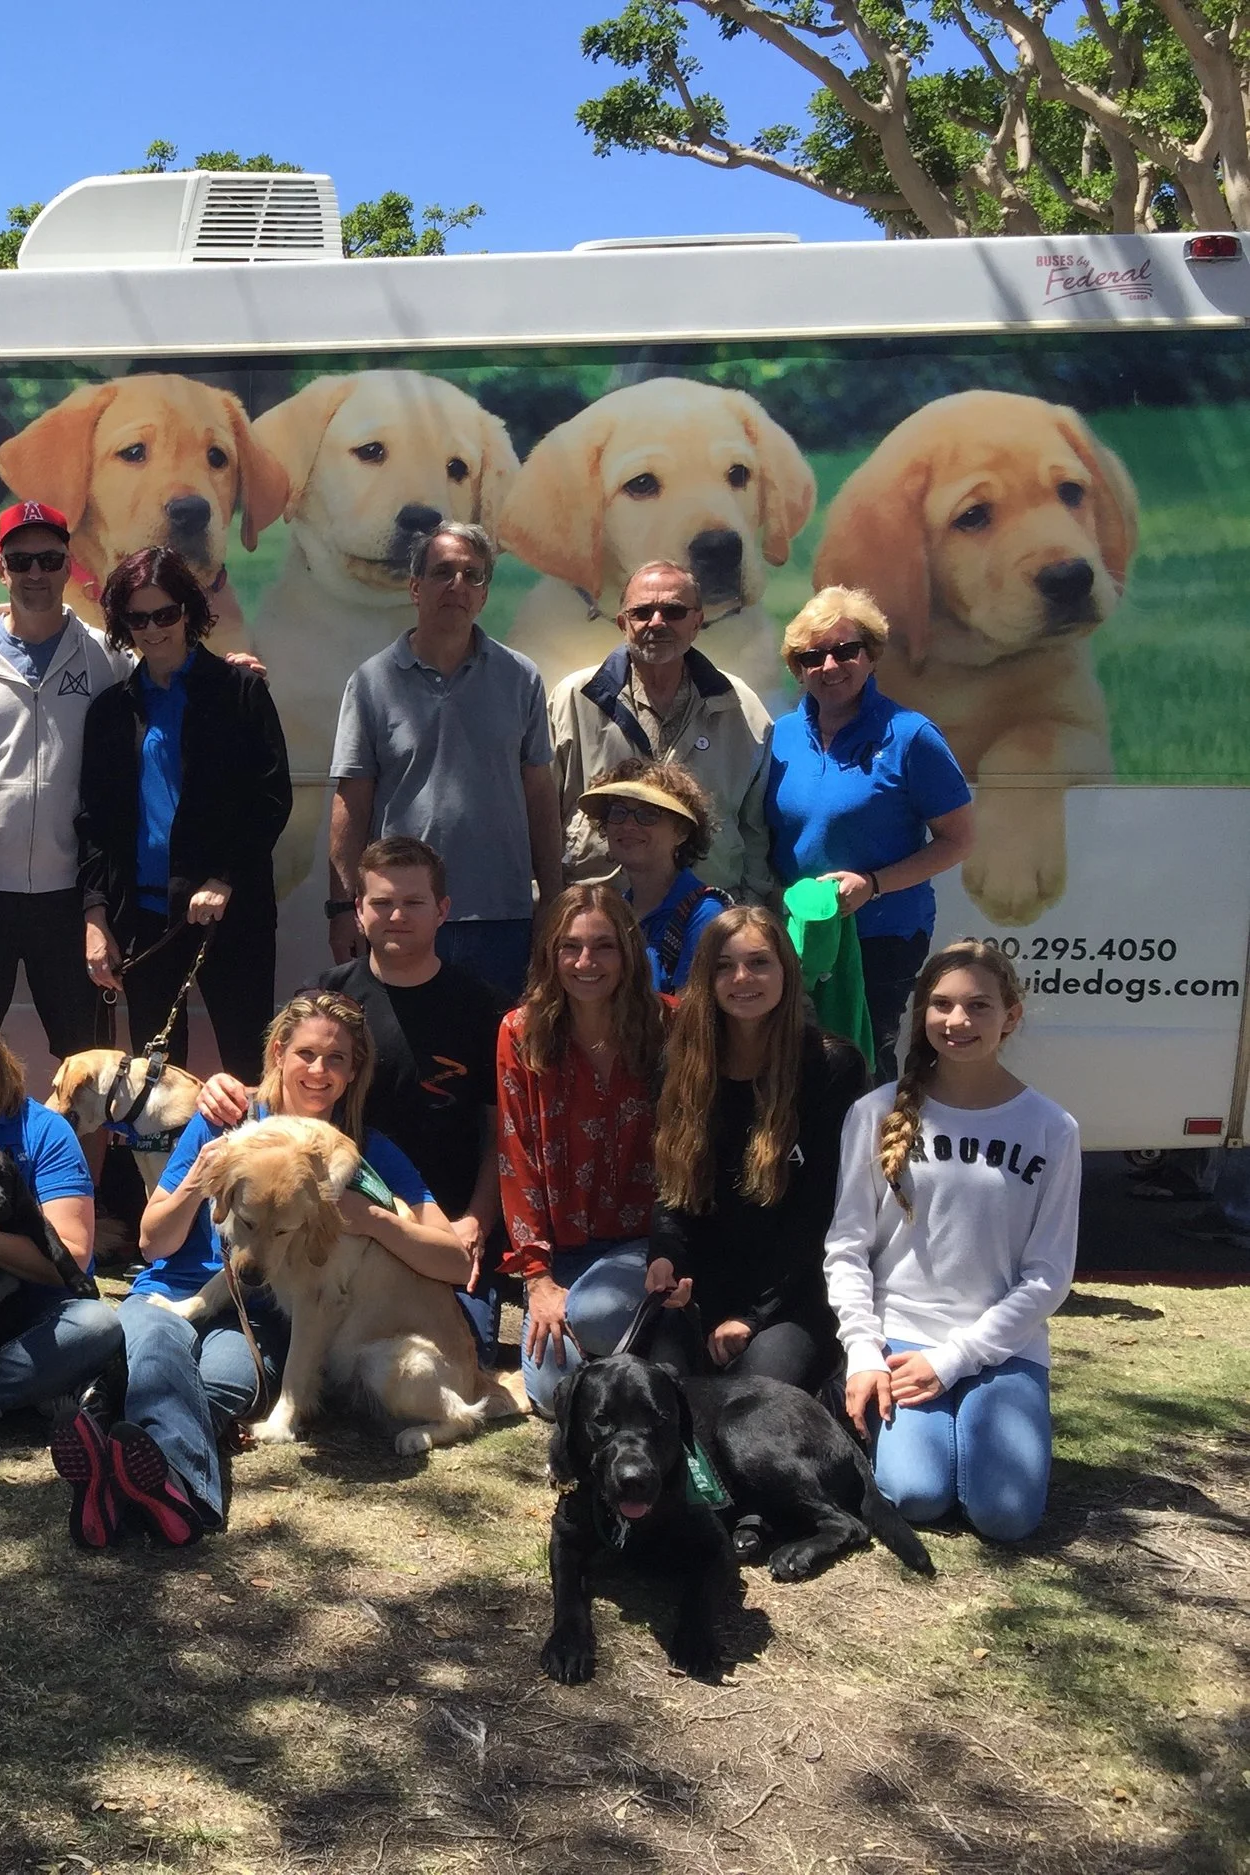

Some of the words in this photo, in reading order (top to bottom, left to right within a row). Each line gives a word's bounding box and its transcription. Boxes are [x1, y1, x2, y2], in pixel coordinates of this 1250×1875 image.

[1036, 255, 1074, 267] BUSES
[1076, 256, 1090, 268] by
[1045, 258, 1152, 296] Federal
[1018, 968, 1240, 1004] uidedogs.com
[909, 1134, 1047, 1186] ROUBLE
